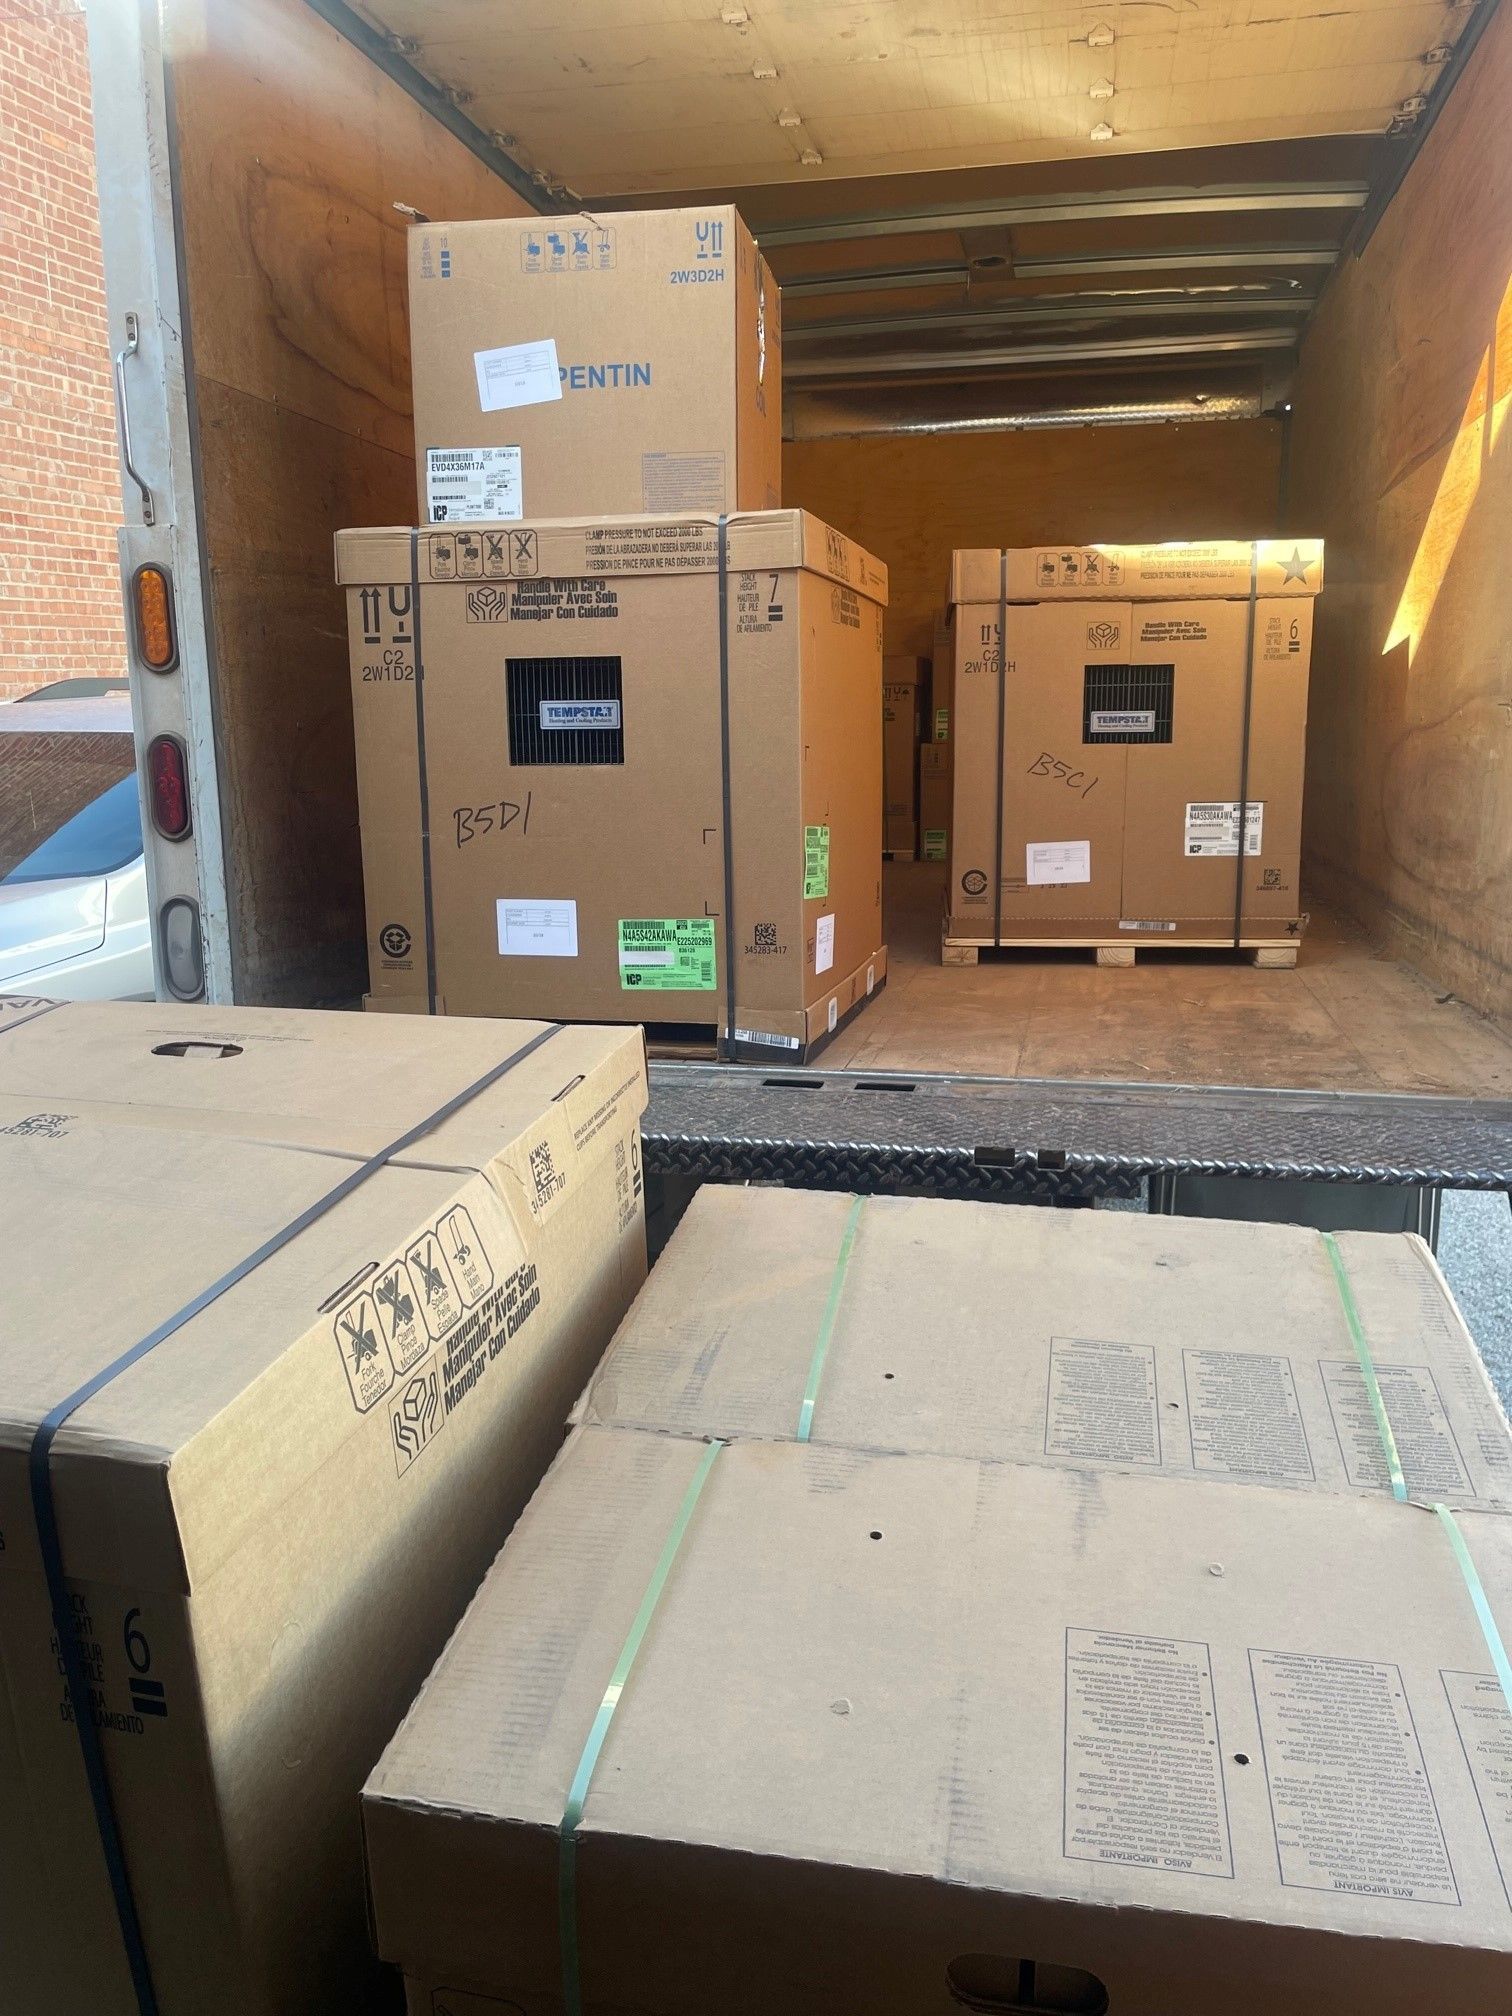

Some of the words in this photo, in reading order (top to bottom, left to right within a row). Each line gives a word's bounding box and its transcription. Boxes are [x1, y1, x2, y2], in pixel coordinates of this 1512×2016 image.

[671, 270, 724, 284] 2W3D2H
[432, 462, 484, 471] EVD4X36M17A
[433, 506, 447, 520] ICP
[586, 530, 603, 540] CLAMP
[605, 529, 633, 540] PRESSURE
[635, 529, 642, 539] TO
[643, 529, 654, 538] NOT
[655, 528, 677, 538] EXCEED
[692, 527, 703, 536] LBS
[680, 542, 702, 552] SUPERAR
[703, 542, 712, 551] LAS
[586, 559, 612, 570] PRESSION
[614, 559, 621, 570] DE
[622, 558, 638, 569] PINCE
[640, 558, 655, 568] POUR
[656, 558, 663, 568] NE
[665, 557, 675, 567] PAS
[677, 556, 705, 567] DÉPASSER
[518, 580, 550, 593] Handle
[554, 580, 578, 592] With
[581, 579, 605, 592] Care
[769, 574, 778, 602] 7
[512, 593, 563, 607] Manipuler
[566, 592, 592, 604] Avec
[596, 591, 617, 603] Soin
[511, 606, 553, 621] Manejar
[557, 606, 575, 619] Con
[578, 605, 618, 618] Cuidado
[1291, 619, 1298, 639] 6
[384, 650, 404, 665] C2
[983, 650, 1000, 661] C2
[965, 662, 1016, 672] 2W1DH
[1190, 845, 1202, 853] ICP
[623, 930, 676, 942] N4A5S42AKAWA
[745, 946, 788, 954] 345283-417
[626, 974, 642, 985] ICP
[631, 1129, 637, 1170] 6
[462, 1262, 476, 1279] Hand
[466, 1274, 480, 1289] Main
[470, 1285, 484, 1300] Mano
[442, 1315, 492, 1387] Manipuler
[495, 1286, 517, 1327] Avec
[518, 1264, 537, 1297] Soin
[397, 1324, 415, 1345] Clamp
[402, 1337, 417, 1355] Pince
[445, 1350, 486, 1415] Manejar
[488, 1328, 506, 1361] Con
[507, 1286, 540, 1338] Cuidado
[362, 1362, 374, 1381] Fork
[360, 1370, 384, 1396] Fourche
[362, 1380, 387, 1407] Tenedor
[124, 1608, 150, 1673] 6
[1075, 1827, 1106, 1837] durante
[1111, 1823, 1152, 1834] productos
[1109, 1832, 1134, 1840] daños
[1139, 1844, 1157, 1852] será
[1172, 1849, 1212, 1859] Vendedor
[1099, 1850, 1157, 1862] IMPORTANTE
[1164, 1858, 1192, 1867] AVISO
[1308, 1859, 1366, 1871] marchandise
[1378, 1867, 1398, 1875] pour
[1332, 1881, 1389, 1893] IMPORTANT
[1401, 1879, 1439, 1889] vendeur
[1391, 1888, 1414, 1896] AVIS
